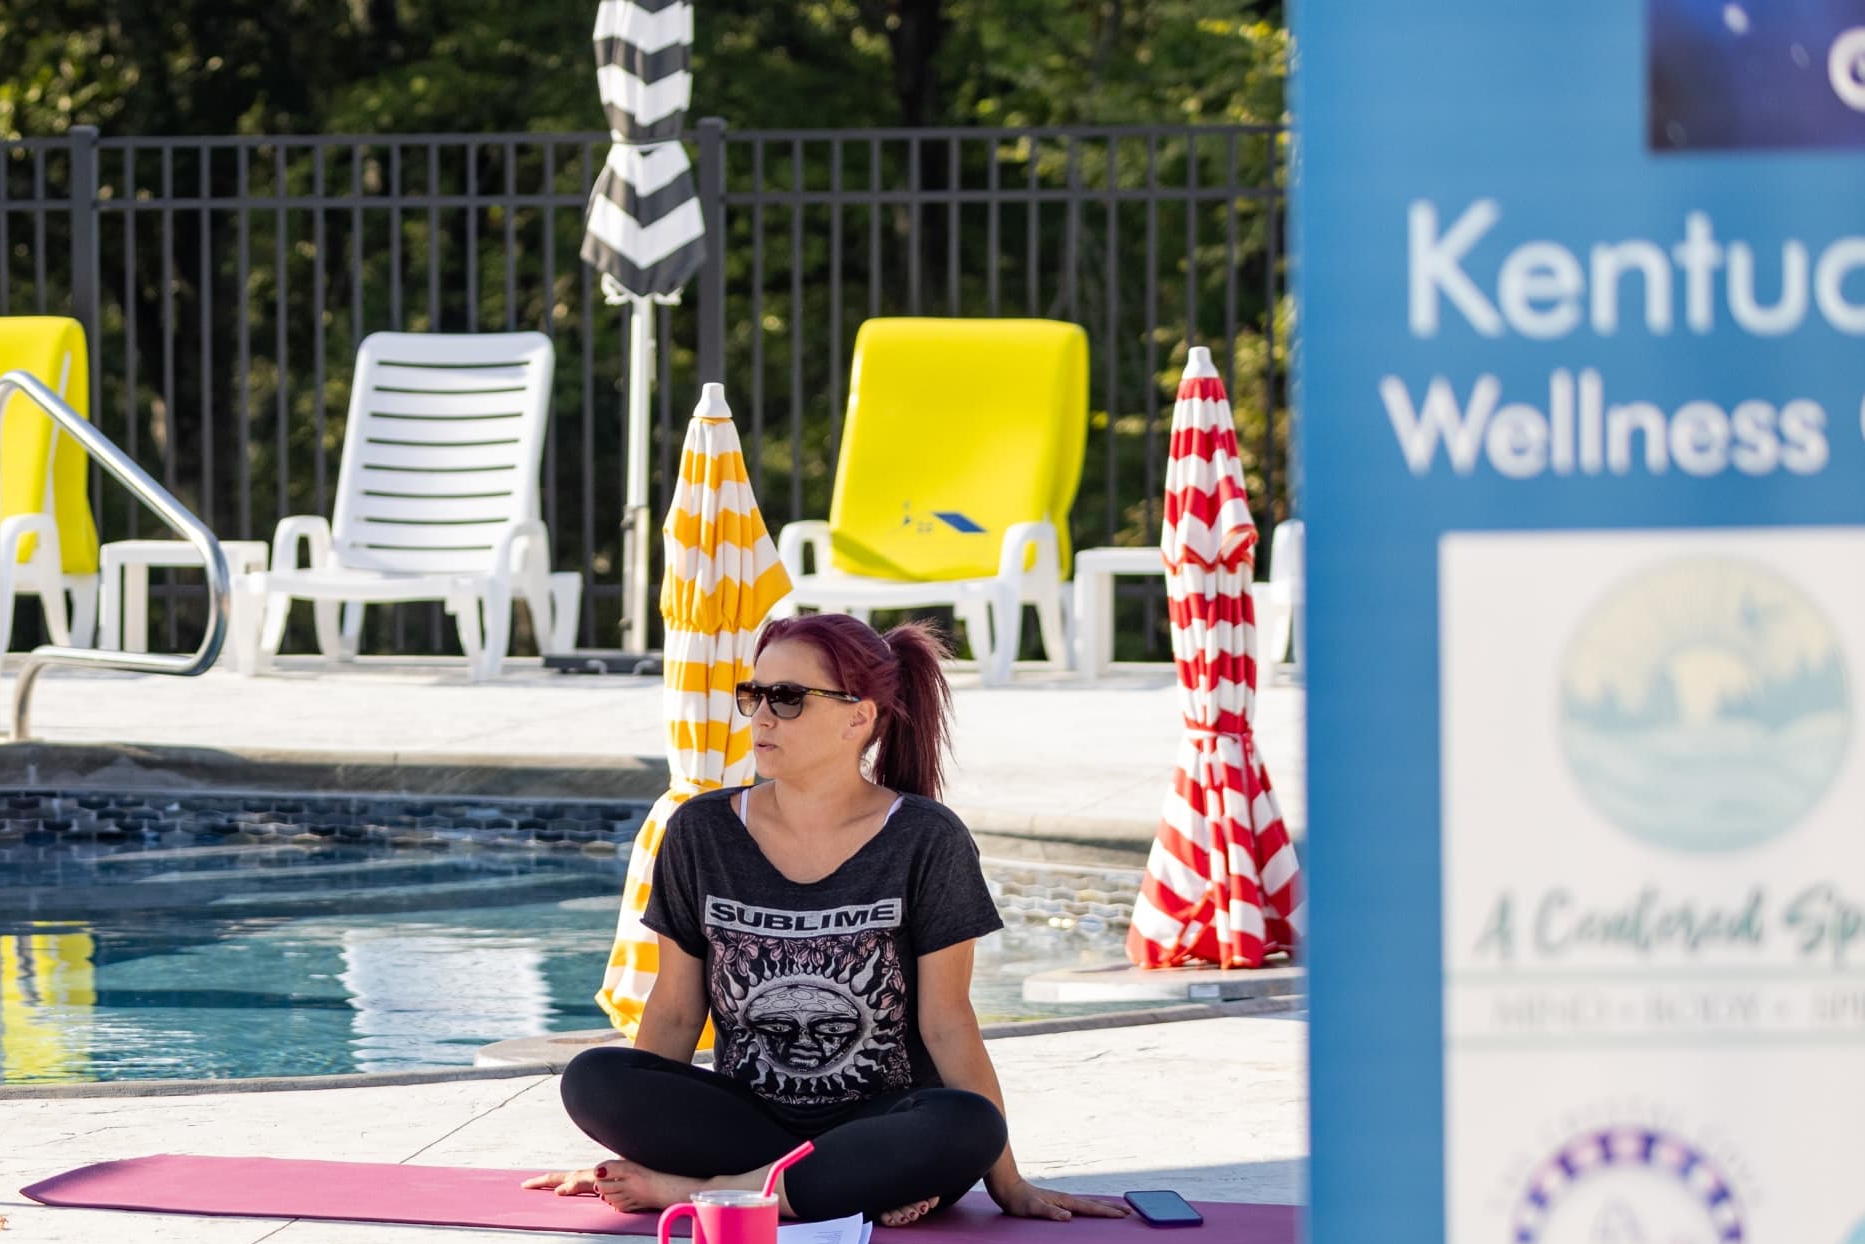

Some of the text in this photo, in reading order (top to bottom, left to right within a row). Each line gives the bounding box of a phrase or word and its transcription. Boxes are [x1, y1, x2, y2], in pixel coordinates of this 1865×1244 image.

[1407, 198, 1865, 340] Kentuc
[1378, 366, 1831, 479] Wellness
[708, 901, 896, 931] SUBLIME
